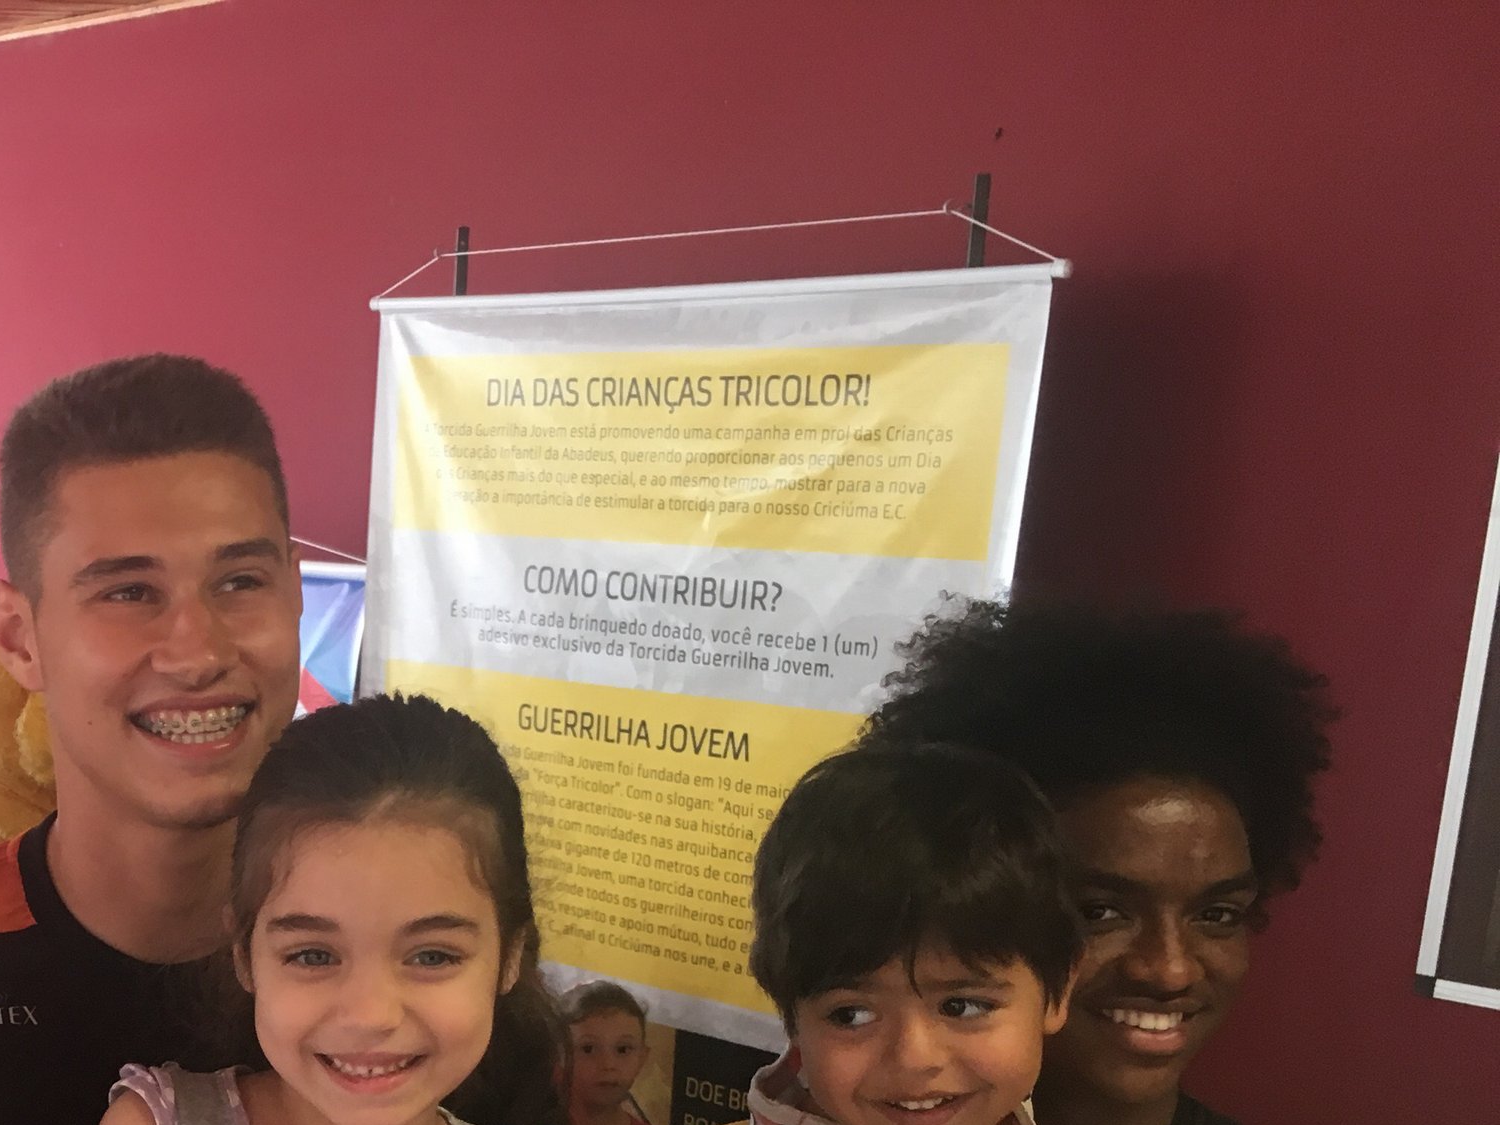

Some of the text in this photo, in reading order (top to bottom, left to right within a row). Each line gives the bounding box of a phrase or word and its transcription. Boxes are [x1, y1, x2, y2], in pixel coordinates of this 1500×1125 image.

[487, 374, 871, 414] DIA DAS CRIANÇAS TRICOLOR!
[444, 445, 497, 459] Educação
[500, 446, 542, 460] Infantil
[544, 447, 559, 460] da
[562, 447, 617, 463] Abadeus,
[621, 448, 682, 466] querendo
[686, 449, 775, 470] proporcionar
[779, 452, 804, 465] aos
[808, 453, 883, 470] pequenos
[888, 454, 912, 468] um
[916, 452, 942, 468] Dia
[475, 423, 527, 438] Guerrilha
[530, 424, 567, 438] Jovem
[570, 423, 597, 439] está
[599, 424, 679, 443] promovendo
[683, 428, 712, 440] uma
[716, 425, 790, 445] campanha
[794, 427, 817, 441] em
[821, 426, 850, 446] prol
[854, 426, 881, 442] das
[886, 425, 953, 446] Crianças
[456, 469, 505, 484] Crianças
[507, 470, 534, 484] mais
[537, 470, 553, 483] do
[555, 473, 578, 486] que
[581, 471, 636, 488] especial,
[639, 473, 647, 485] e
[650, 474, 667, 486] ao
[670, 475, 720, 489] mesmo
[723, 475, 771, 491] tempo,
[775, 477, 832, 492] mostrar
[836, 479, 871, 496] para
[875, 481, 884, 493] a
[888, 481, 926, 495] nova
[491, 491, 499, 503] a
[501, 491, 573, 508] importância
[576, 492, 591, 507] de
[594, 493, 654, 511] estimular
[658, 498, 666, 510] a
[668, 496, 715, 512] torcida
[718, 500, 749, 515] para
[753, 502, 761, 514] o
[766, 502, 810, 516] nosso
[813, 501, 878, 518] Criciúma
[523, 565, 783, 612] COMO CONTRIBUIR?
[450, 599, 878, 659] É simples. A cada brinquedo doado, você recebe 1 (um)
[478, 627, 834, 679] adesivo exclusivo da Torcida Guerrilha Jovem.
[518, 703, 750, 762] GUERRILHA JOVEM
[523, 746, 575, 766] Guerrilha
[577, 759, 615, 773] Jovem
[618, 760, 634, 775] foi
[637, 763, 690, 785] fundada
[694, 775, 714, 788] em
[718, 776, 731, 791] 19
[735, 779, 752, 794] de
[559, 797, 652, 825] caracterizou-se
[655, 814, 672, 827] na
[675, 818, 698, 832] sua
[702, 819, 757, 843] história,
[626, 785, 653, 801] Com
[655, 792, 663, 804] o
[718, 798, 754, 819] "Aqui
[558, 818, 582, 833] com
[584, 822, 647, 846] novidades
[651, 835, 673, 850] nas
[676, 840, 753, 864] arquibanca
[565, 841, 610, 858] gigante
[613, 849, 628, 863] de
[631, 851, 651, 868] 120
[654, 857, 699, 878] metros
[703, 864, 720, 881] de
[724, 872, 753, 887] com
[576, 863, 615, 884] Jovem,
[618, 874, 645, 889] uma
[648, 879, 694, 898] torcida
[697, 889, 752, 909] conheci
[559, 902, 606, 924] respeito
[609, 914, 617, 925] e
[619, 916, 654, 935] apoio
[657, 924, 701, 945] mútuo,
[705, 933, 737, 952] tudo
[586, 888, 619, 905] todos
[623, 896, 638, 909] os
[640, 899, 724, 927] guerrilheiros
[728, 916, 753, 931] con
[563, 923, 595, 941] afinal
[608, 935, 660, 957] Criciúma
[663, 948, 687, 963] nos
[691, 954, 719, 972] une,
[722, 959, 731, 972] e
[734, 963, 743, 975] a
[685, 1076, 724, 1106] DOE
